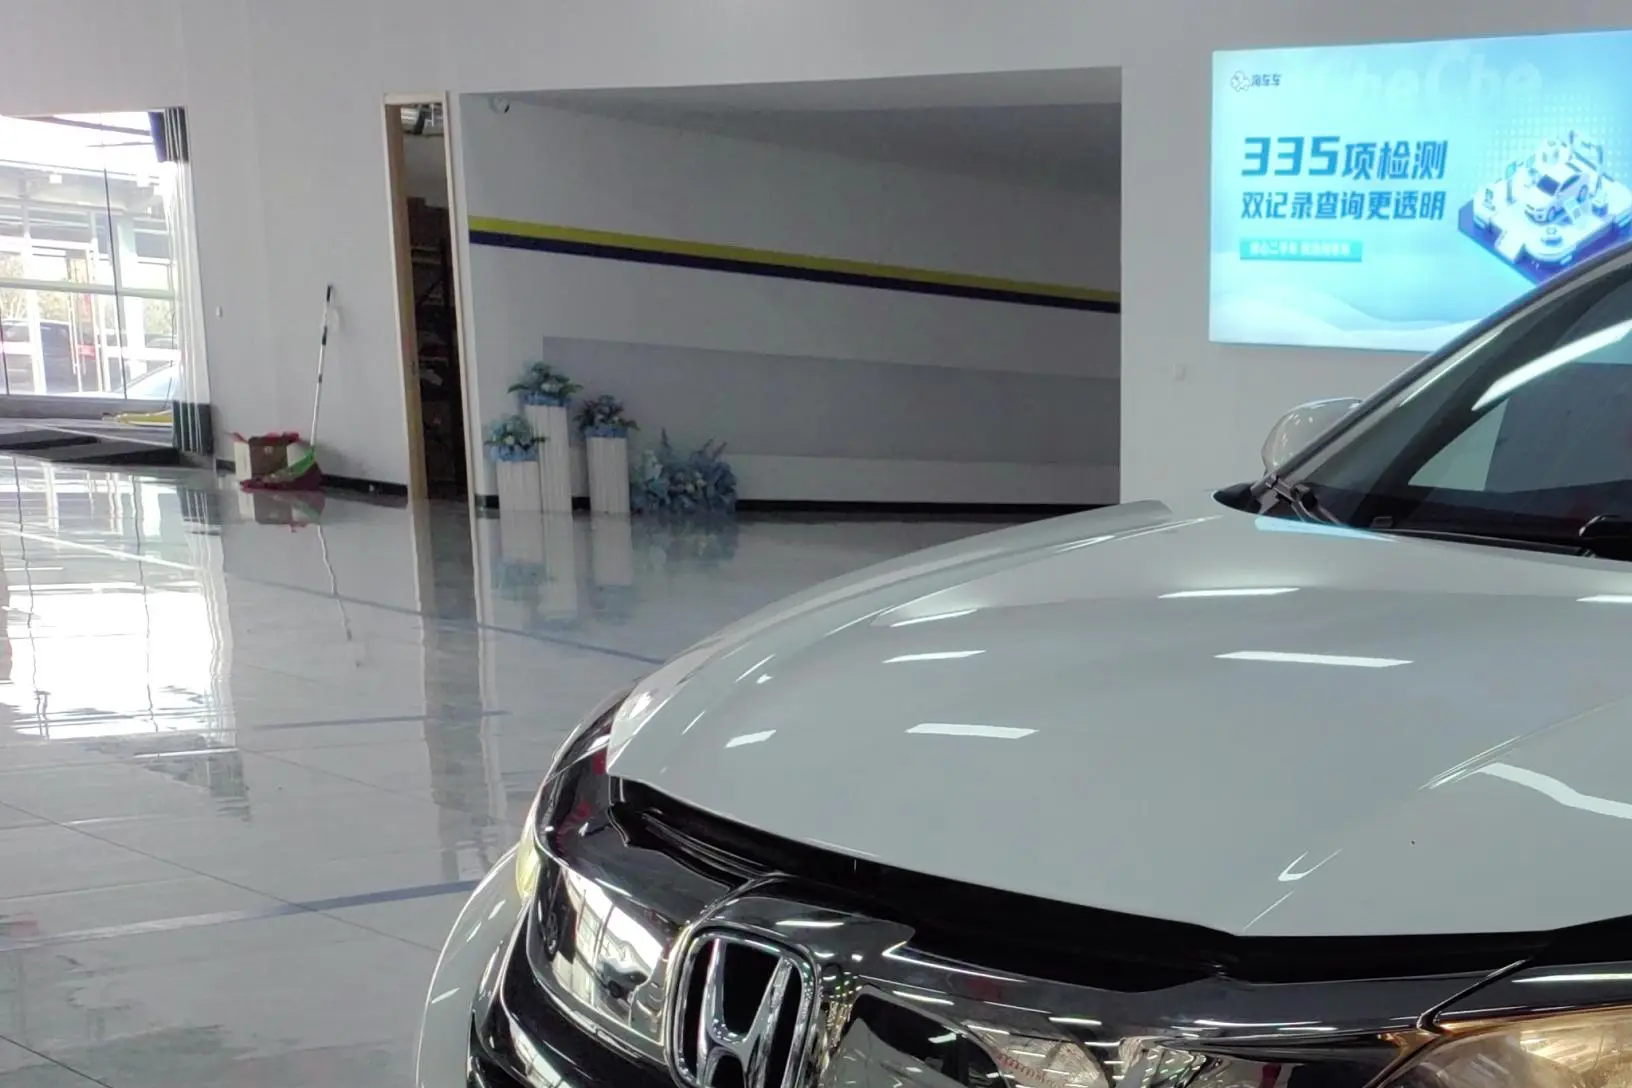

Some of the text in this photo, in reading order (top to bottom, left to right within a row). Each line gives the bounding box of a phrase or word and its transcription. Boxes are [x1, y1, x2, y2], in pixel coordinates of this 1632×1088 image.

[1241, 136, 1448, 181] 335项检测
[1240, 191, 1446, 221] 双记录查询更透明
